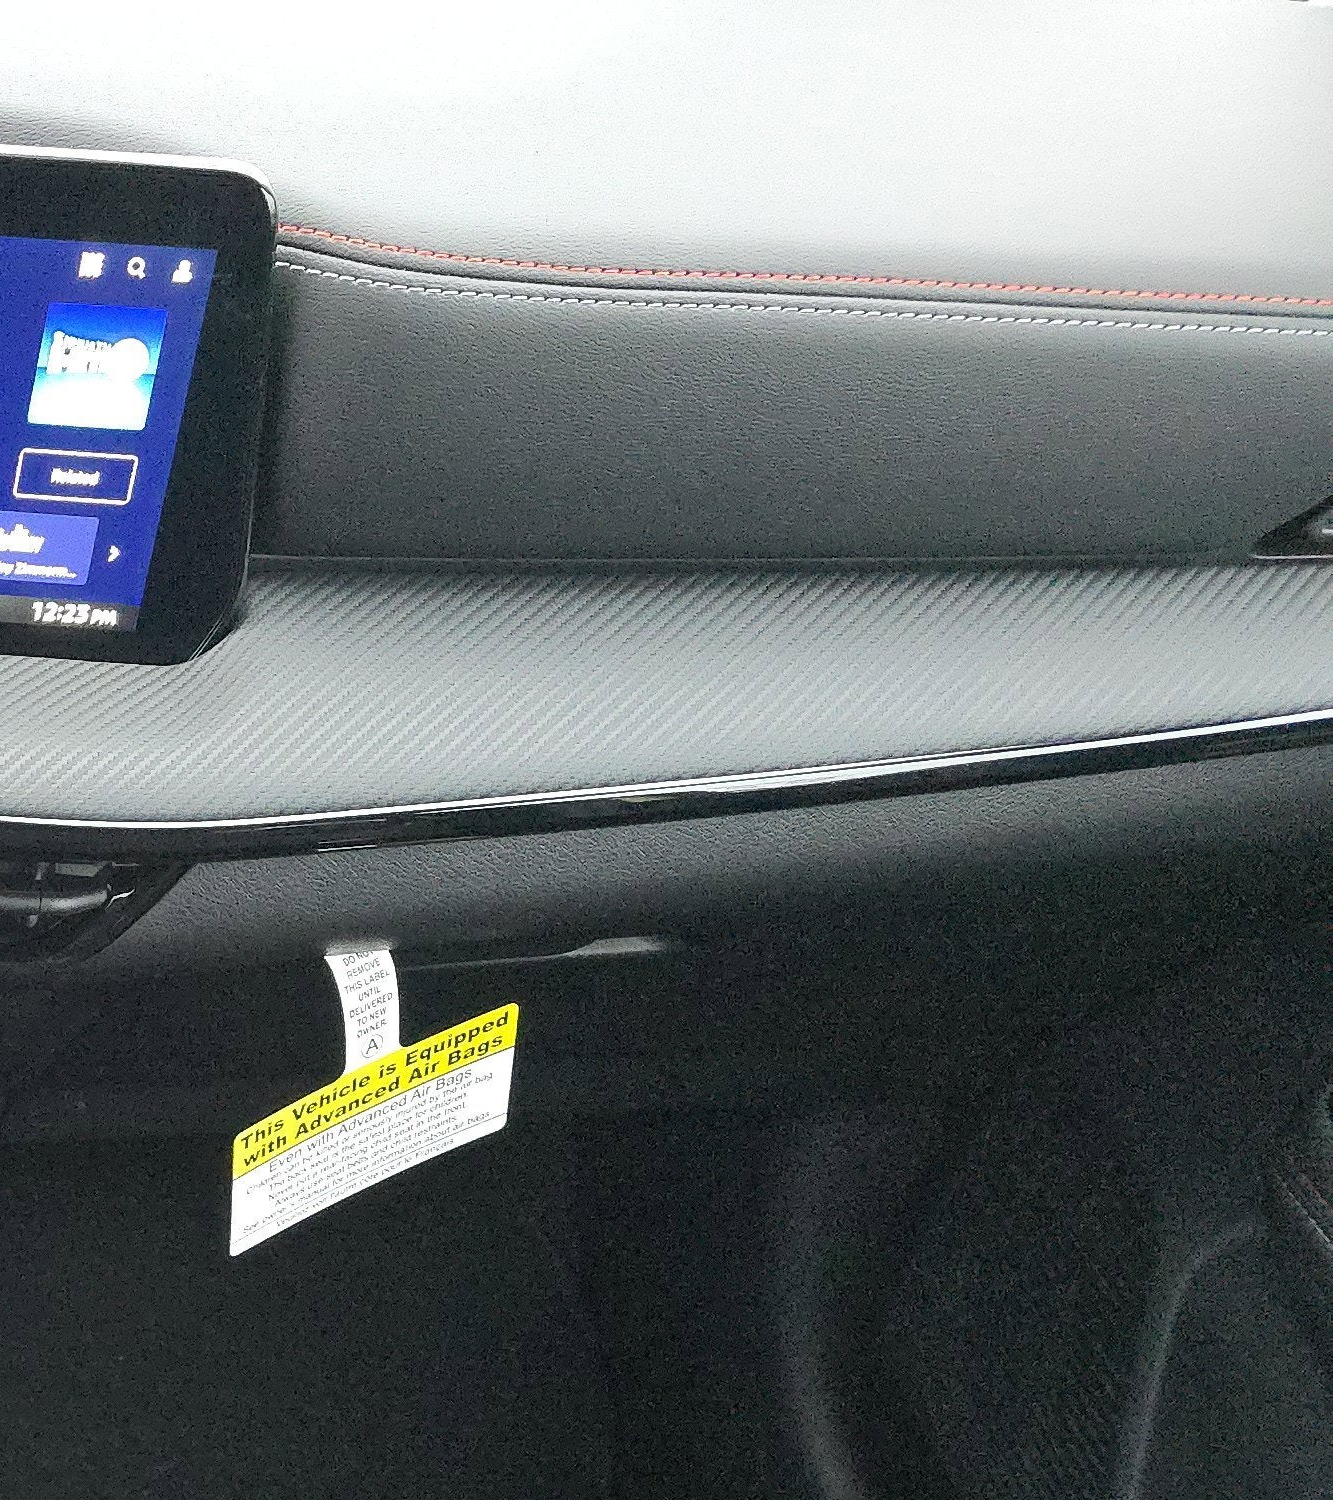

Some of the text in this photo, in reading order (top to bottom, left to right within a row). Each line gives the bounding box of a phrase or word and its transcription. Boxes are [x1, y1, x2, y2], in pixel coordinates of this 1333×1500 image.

[31, 601, 118, 627] 12:23 PM
[344, 969, 390, 995] THIS LABEL
[358, 986, 381, 1001] UNTIL
[349, 992, 393, 1019] DELIVERED
[357, 1007, 387, 1027] TO NEW
[366, 1038, 379, 1055] A
[240, 1011, 509, 1150] This Vehicle is Equipped
[243, 1034, 503, 1167] with Advanced Air Bags
[268, 1068, 472, 1173] Even with Advanced Air Bags
